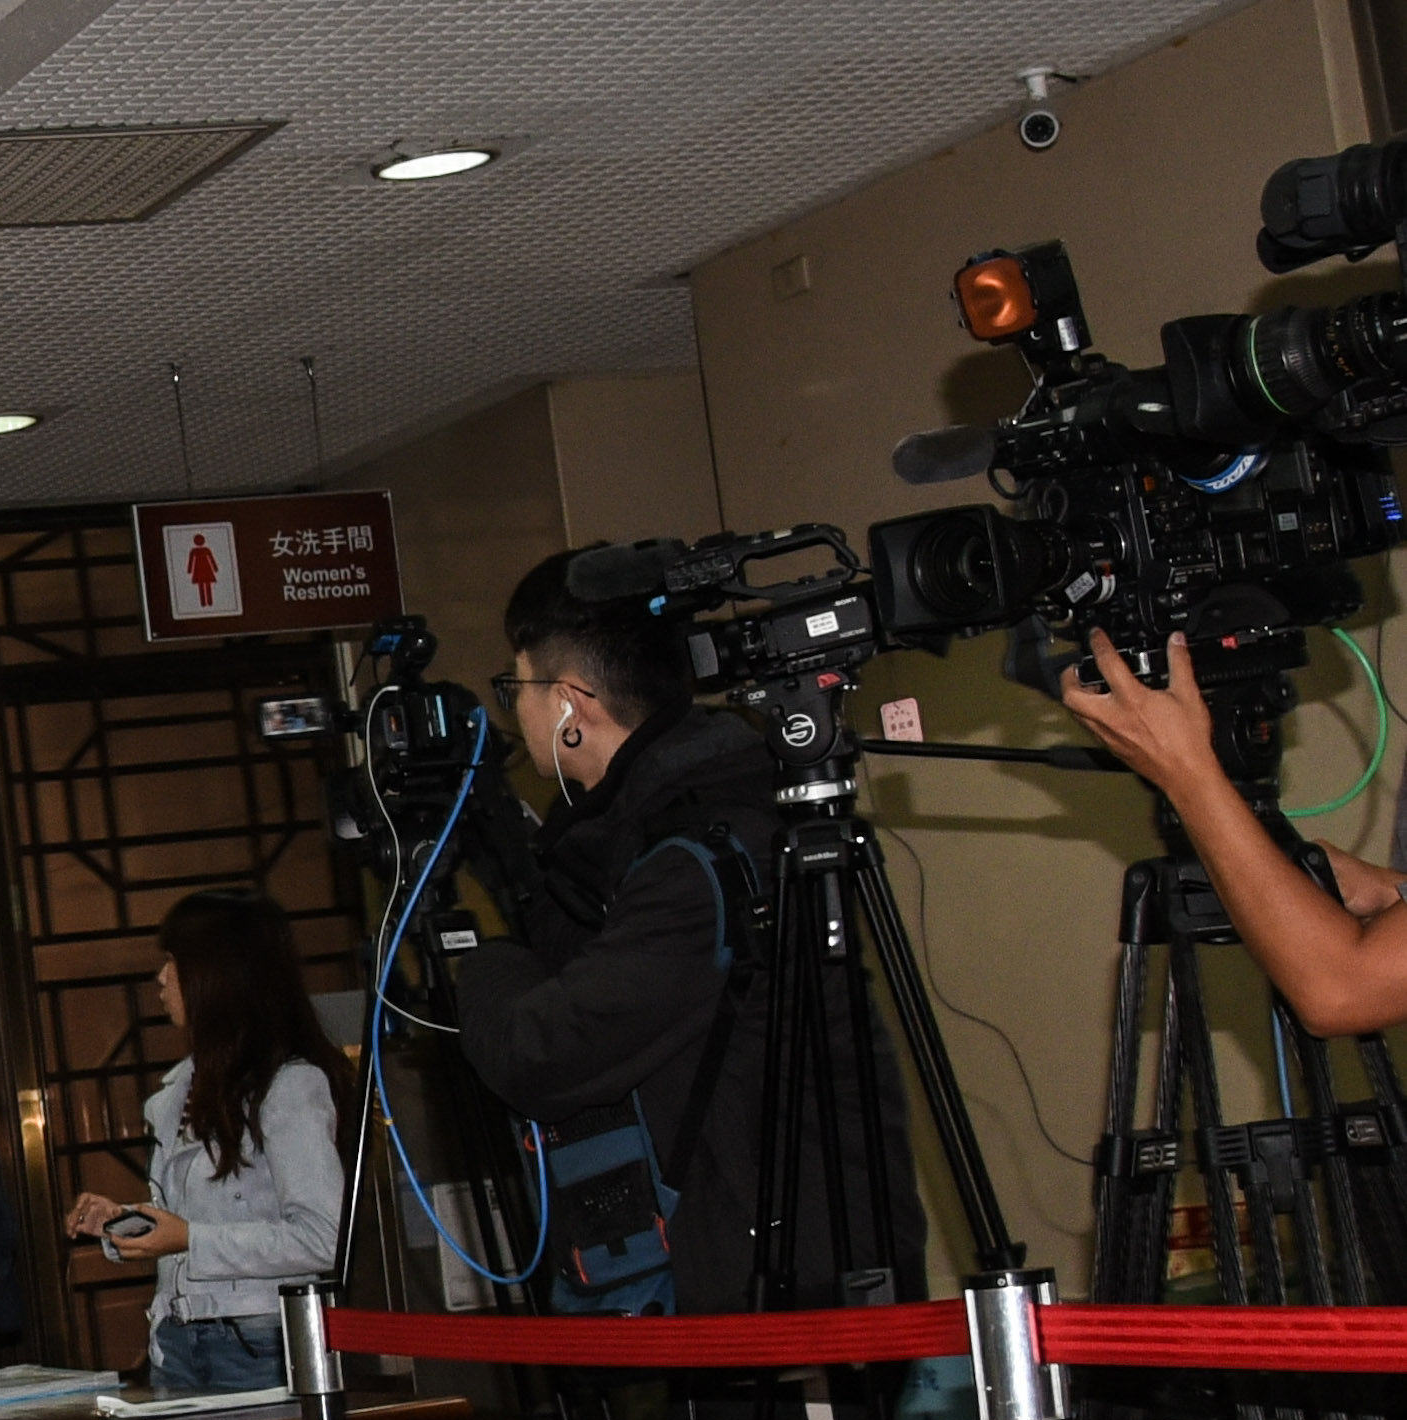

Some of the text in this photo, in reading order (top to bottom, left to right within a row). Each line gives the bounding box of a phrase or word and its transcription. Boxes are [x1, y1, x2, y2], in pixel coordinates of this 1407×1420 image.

[268, 525, 374, 558] 女洗手間
[283, 564, 366, 584] Women's
[283, 583, 371, 601] Restroom
